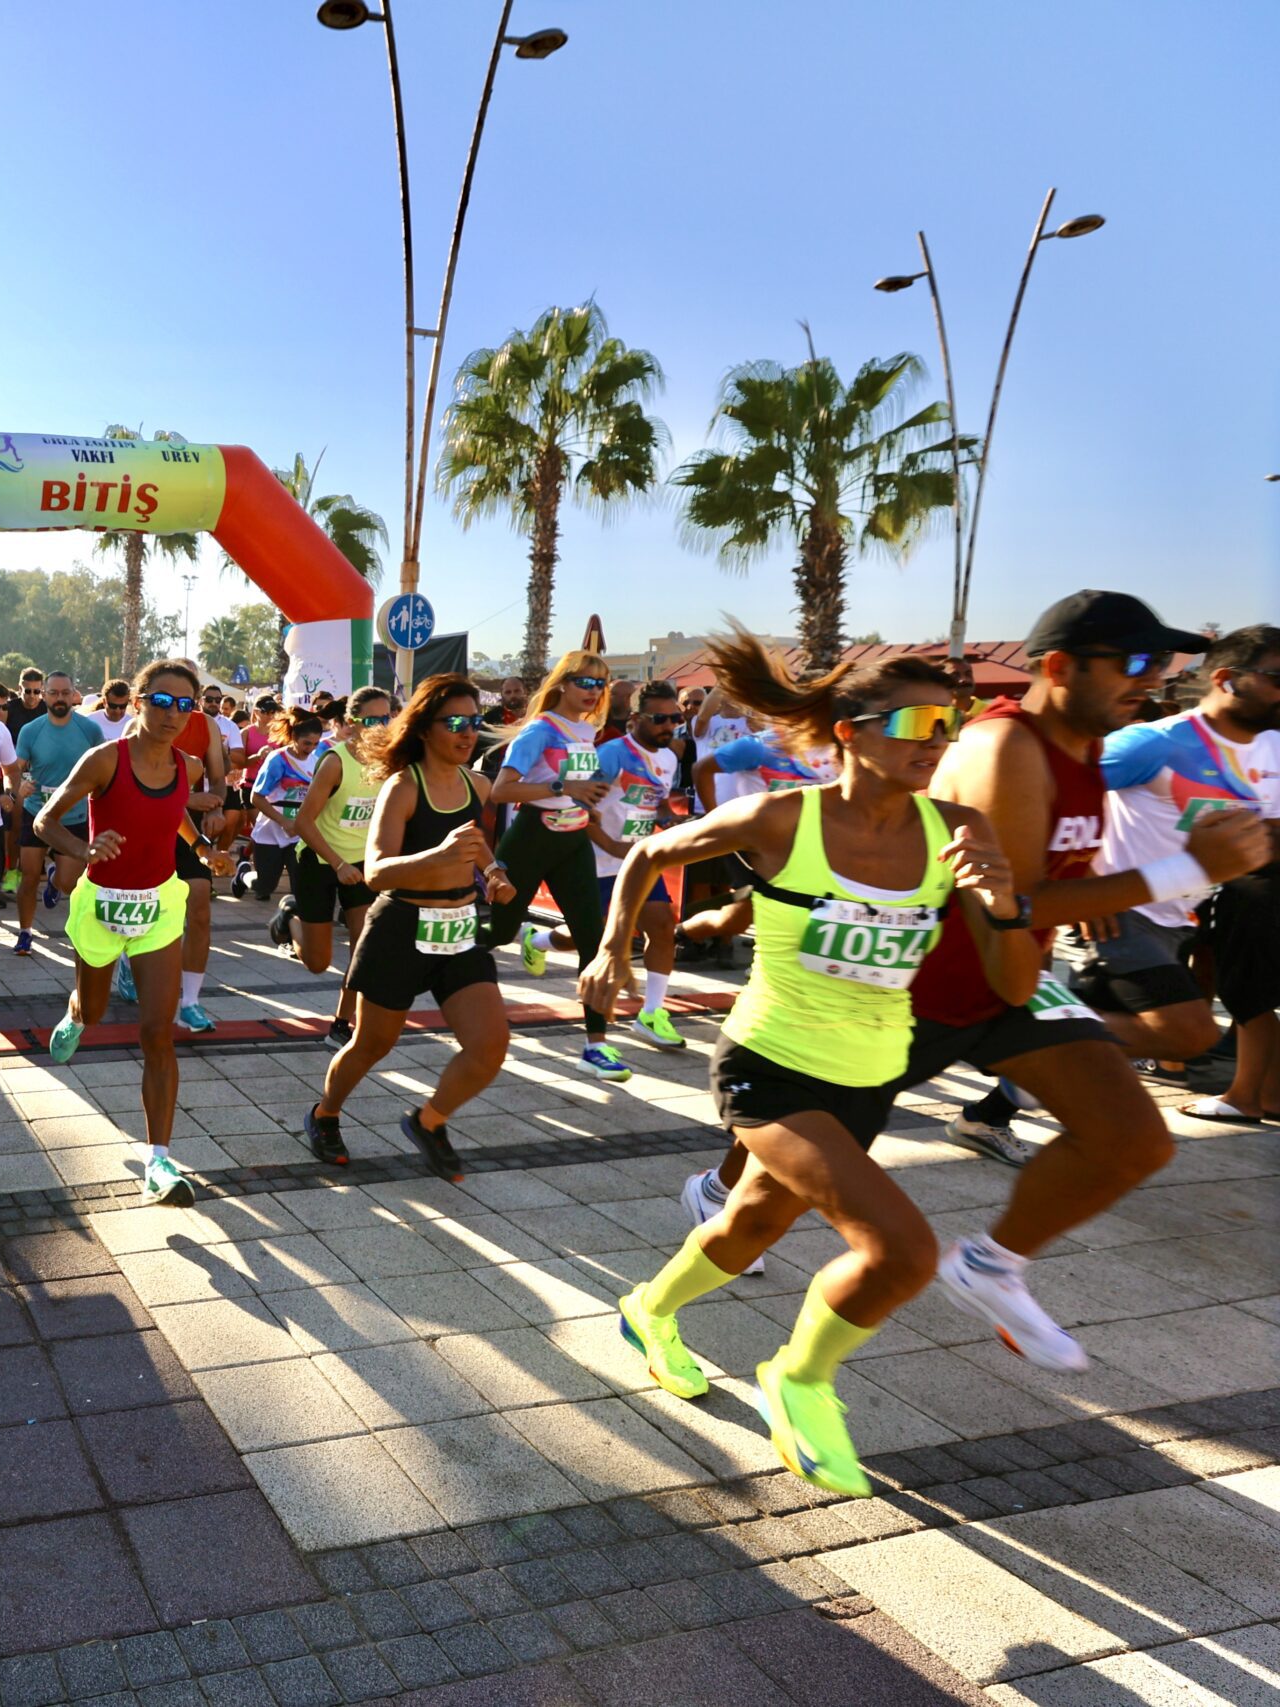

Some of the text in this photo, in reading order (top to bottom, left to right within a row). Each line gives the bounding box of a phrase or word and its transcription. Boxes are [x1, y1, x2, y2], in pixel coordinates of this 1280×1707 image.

[71, 448, 115, 463] VAKFI
[161, 451, 200, 463] UREV
[40, 472, 159, 523] BİTİŞ
[100, 901, 158, 924] 1447
[423, 917, 476, 943] 1122
[816, 922, 927, 967] 1054
